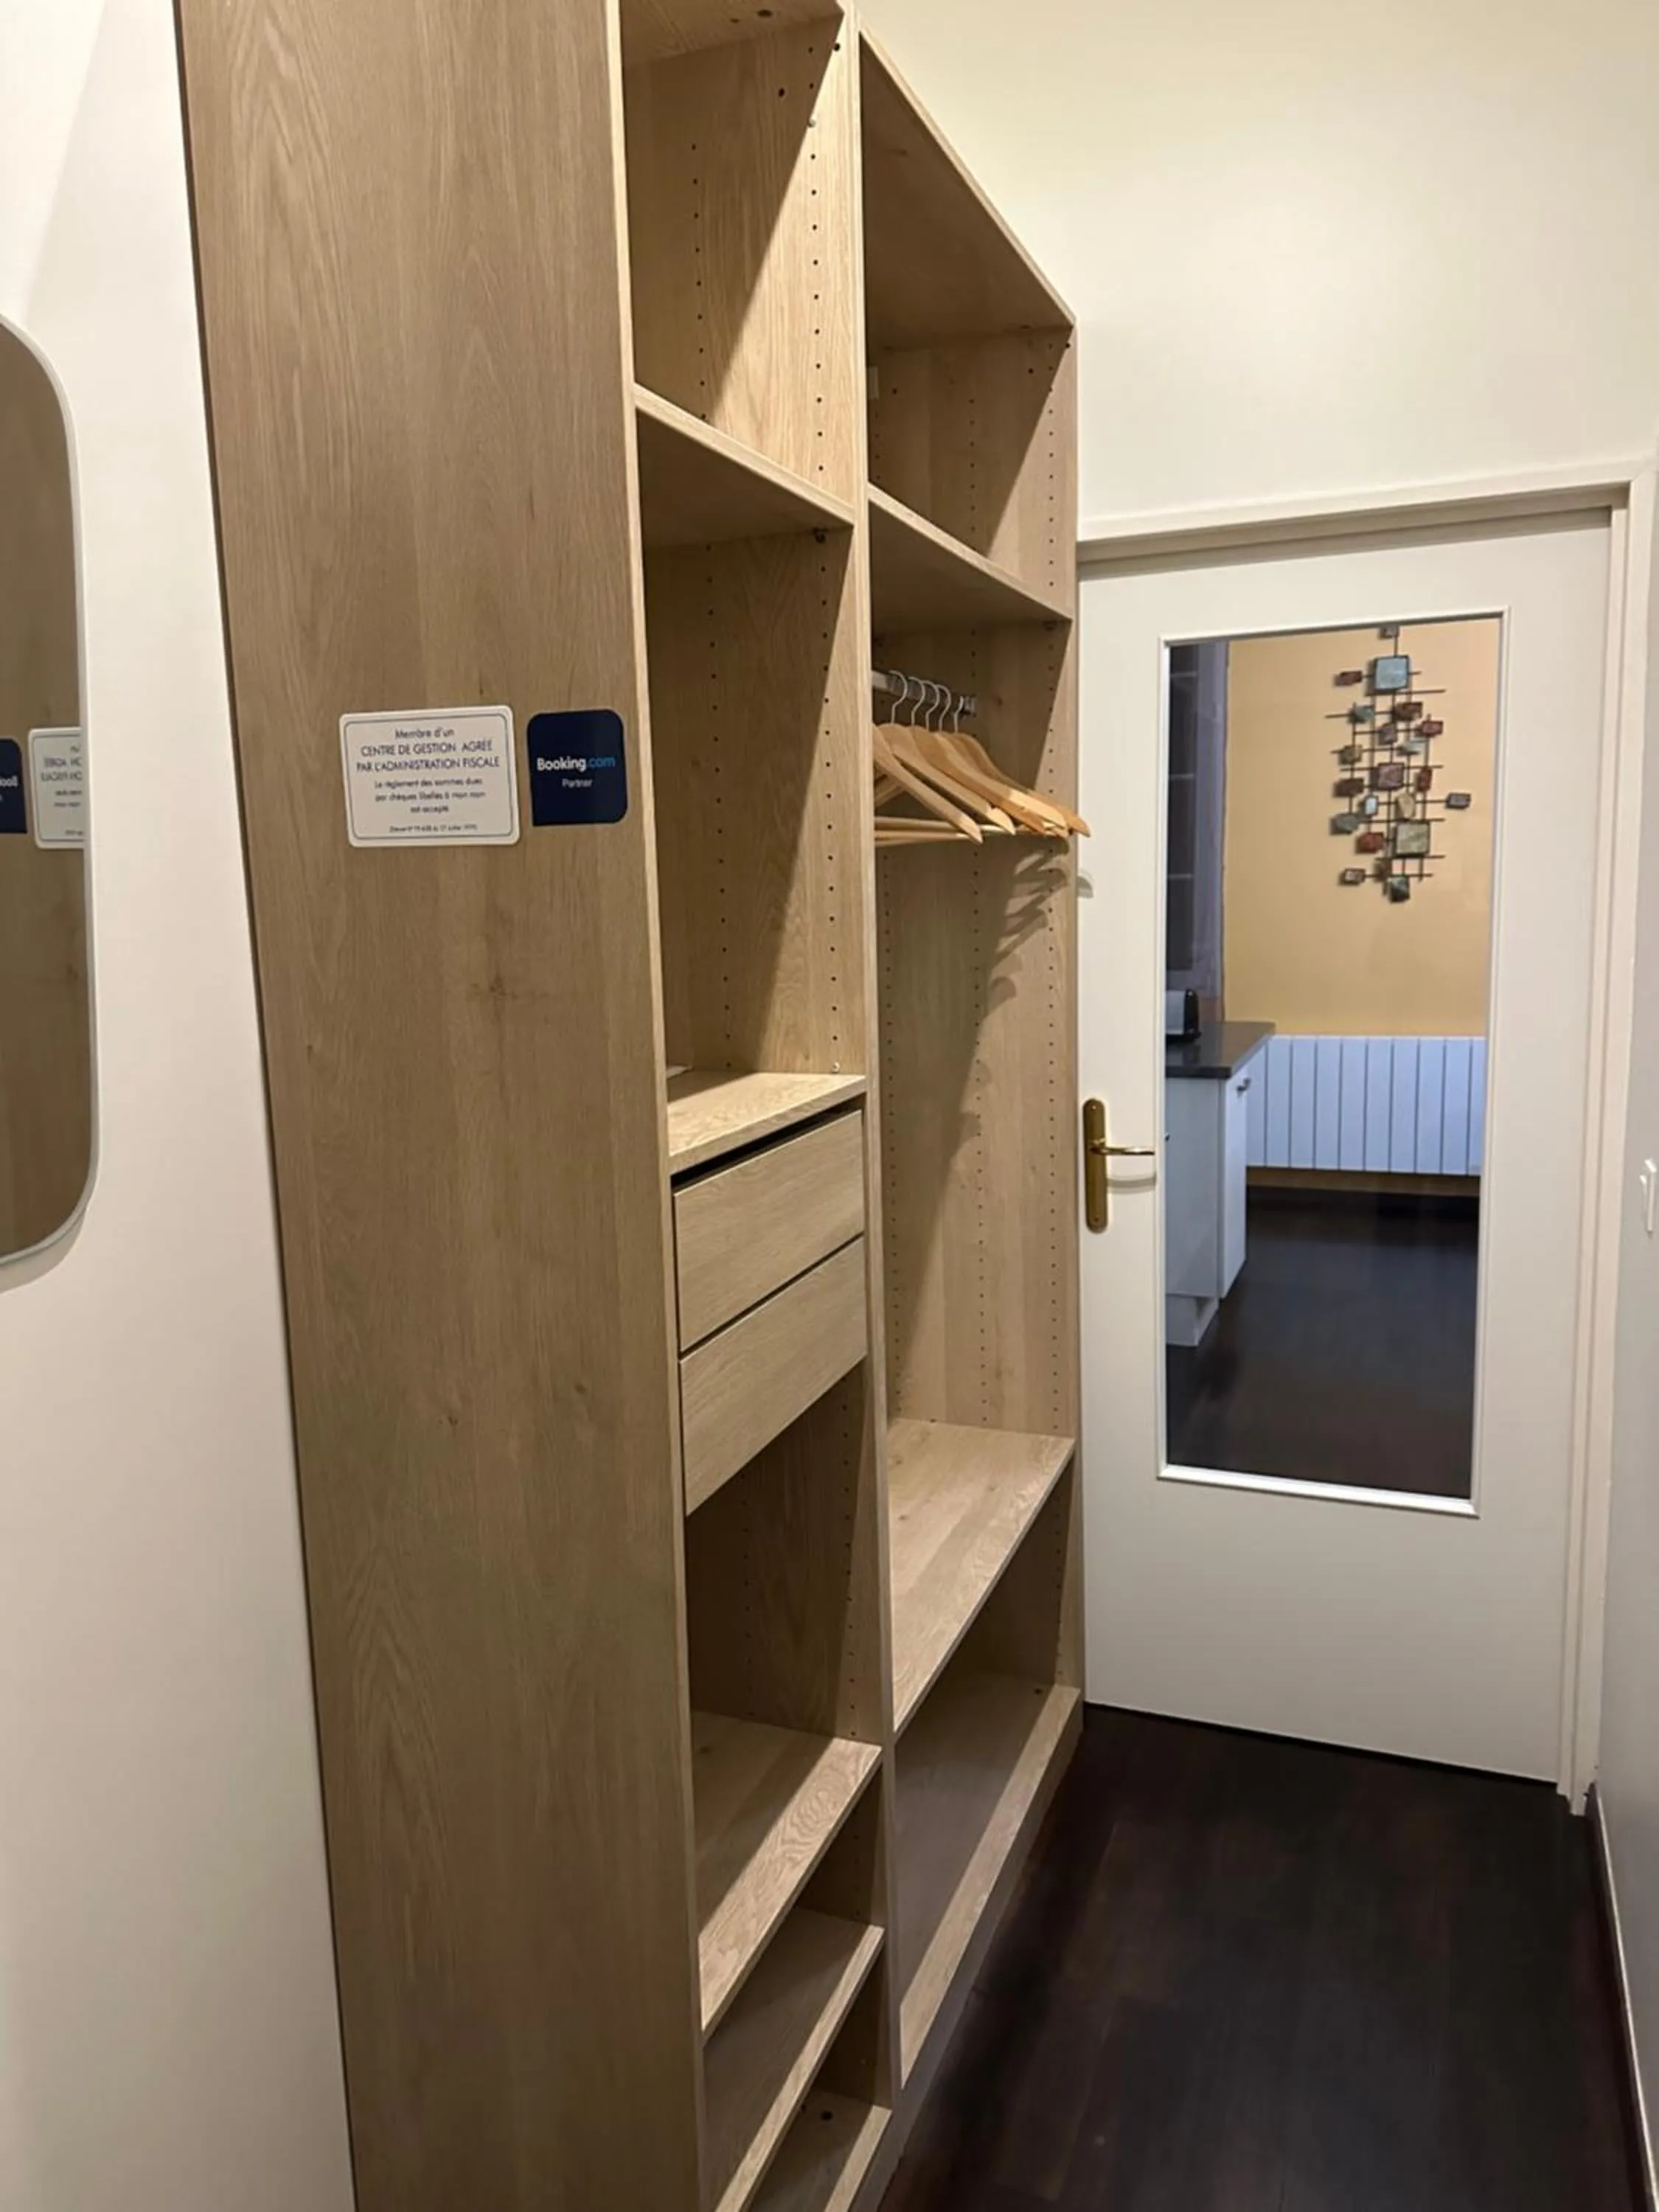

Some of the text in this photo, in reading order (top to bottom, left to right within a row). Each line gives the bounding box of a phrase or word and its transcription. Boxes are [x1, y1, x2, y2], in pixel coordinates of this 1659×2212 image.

[395, 728, 431, 739] Membre
[361, 738, 493, 757] CENTRE DE GESTION AGRÉE
[356, 756, 499, 772] PAR L'ADMINISTRATION FISCALE
[537, 756, 614, 773] Booking.com
[562, 778, 592, 788] Partner
